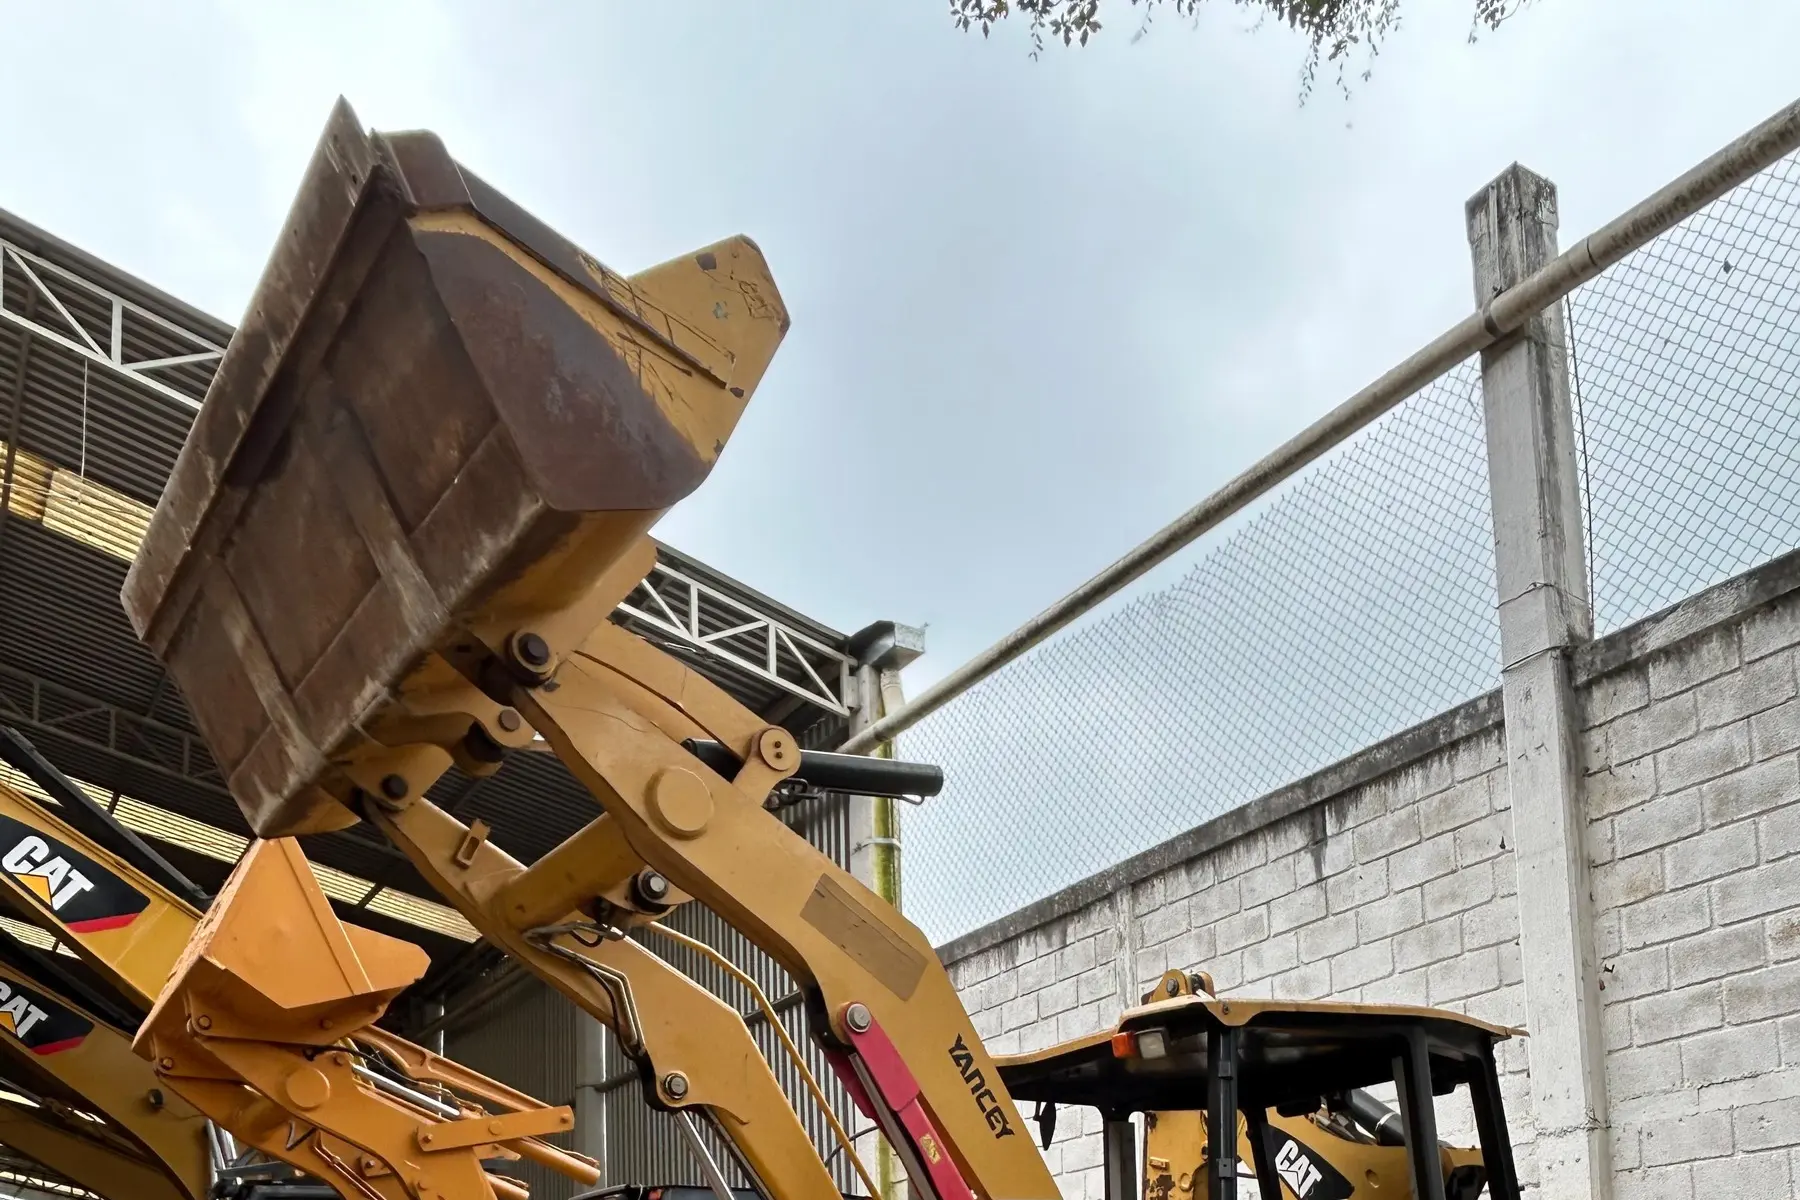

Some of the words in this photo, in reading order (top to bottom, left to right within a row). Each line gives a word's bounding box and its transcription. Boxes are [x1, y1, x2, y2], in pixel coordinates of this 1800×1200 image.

[2, 835, 95, 911] CAT
[949, 1033, 1015, 1139] YANCEY
[1274, 1139, 1323, 1199] CAT
